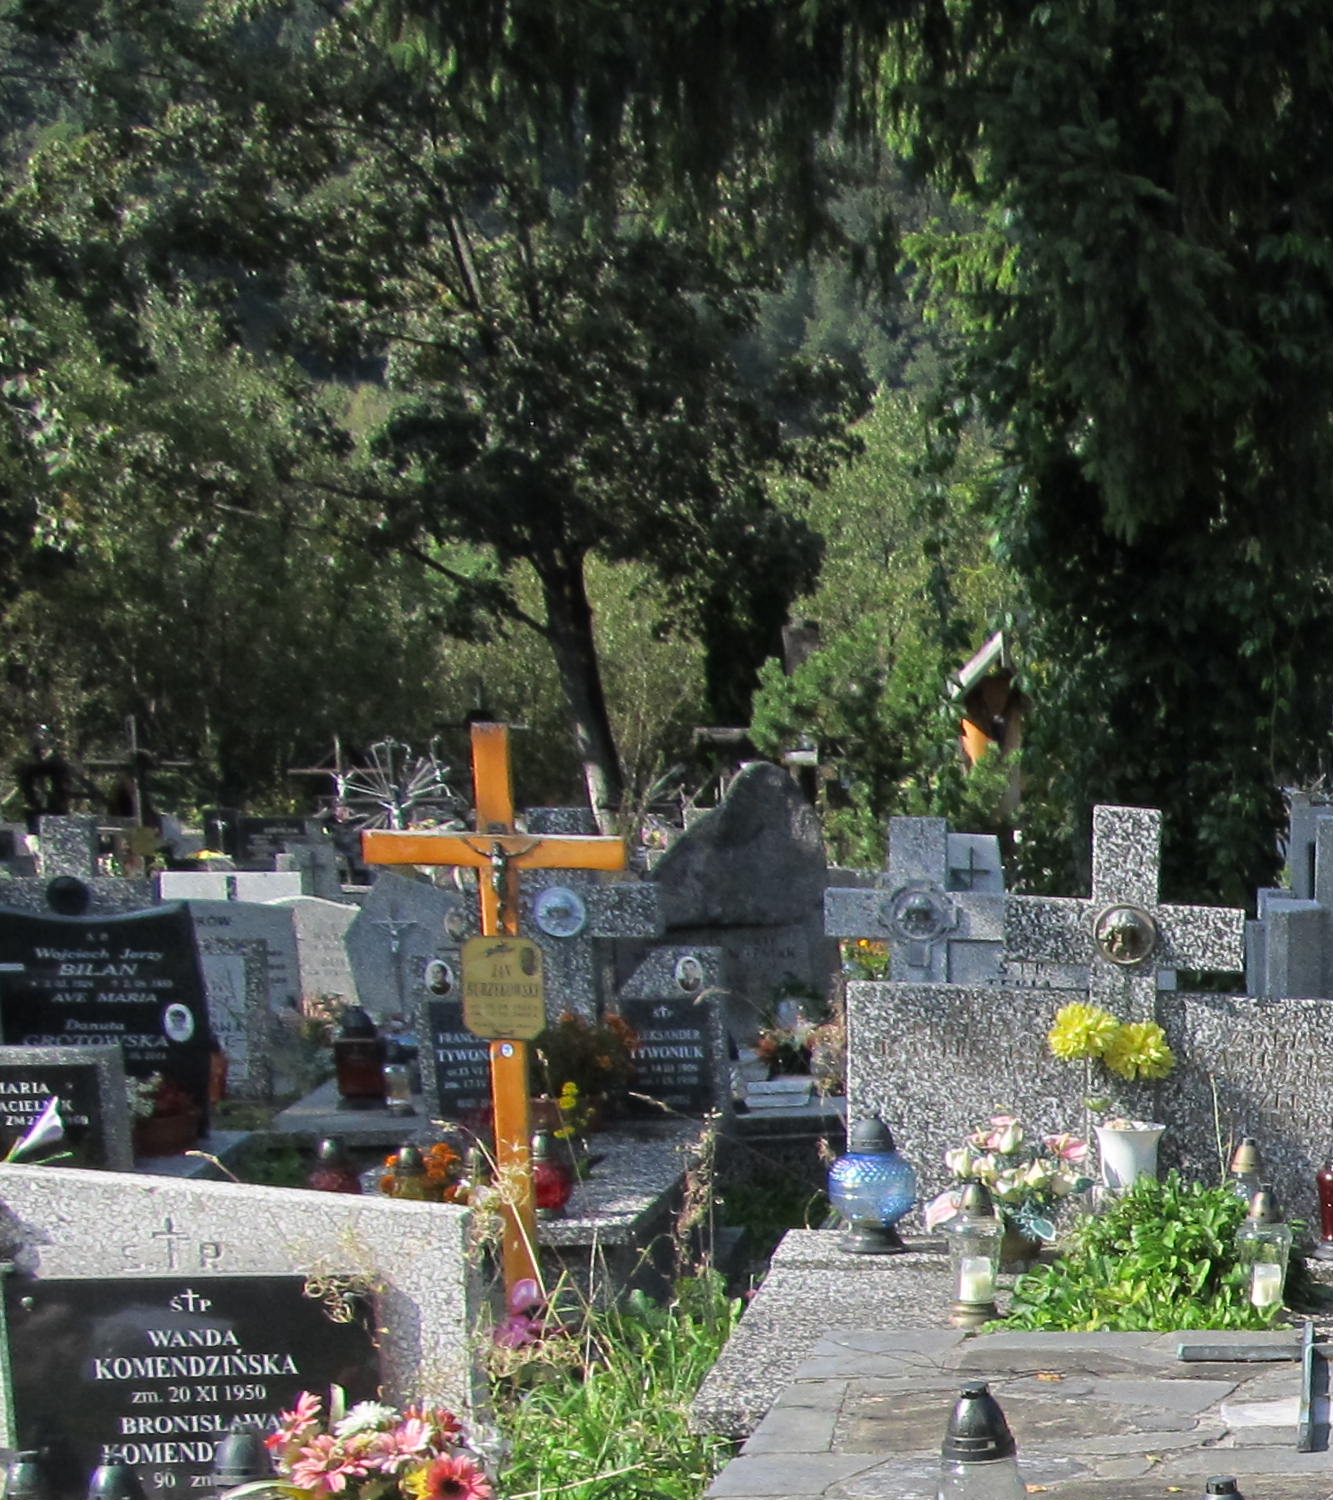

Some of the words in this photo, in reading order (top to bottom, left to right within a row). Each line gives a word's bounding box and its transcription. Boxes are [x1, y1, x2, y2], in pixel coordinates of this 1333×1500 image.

[97, 992, 158, 1002] MARIA
[148, 1330, 241, 1347] WANDA
[95, 1348, 299, 1380] KOMENDZIŃSKA
[168, 1387, 191, 1402] 20
[196, 1387, 218, 1401] XI
[224, 1384, 267, 1401] 1950
[153, 1472, 176, 1488] 90
